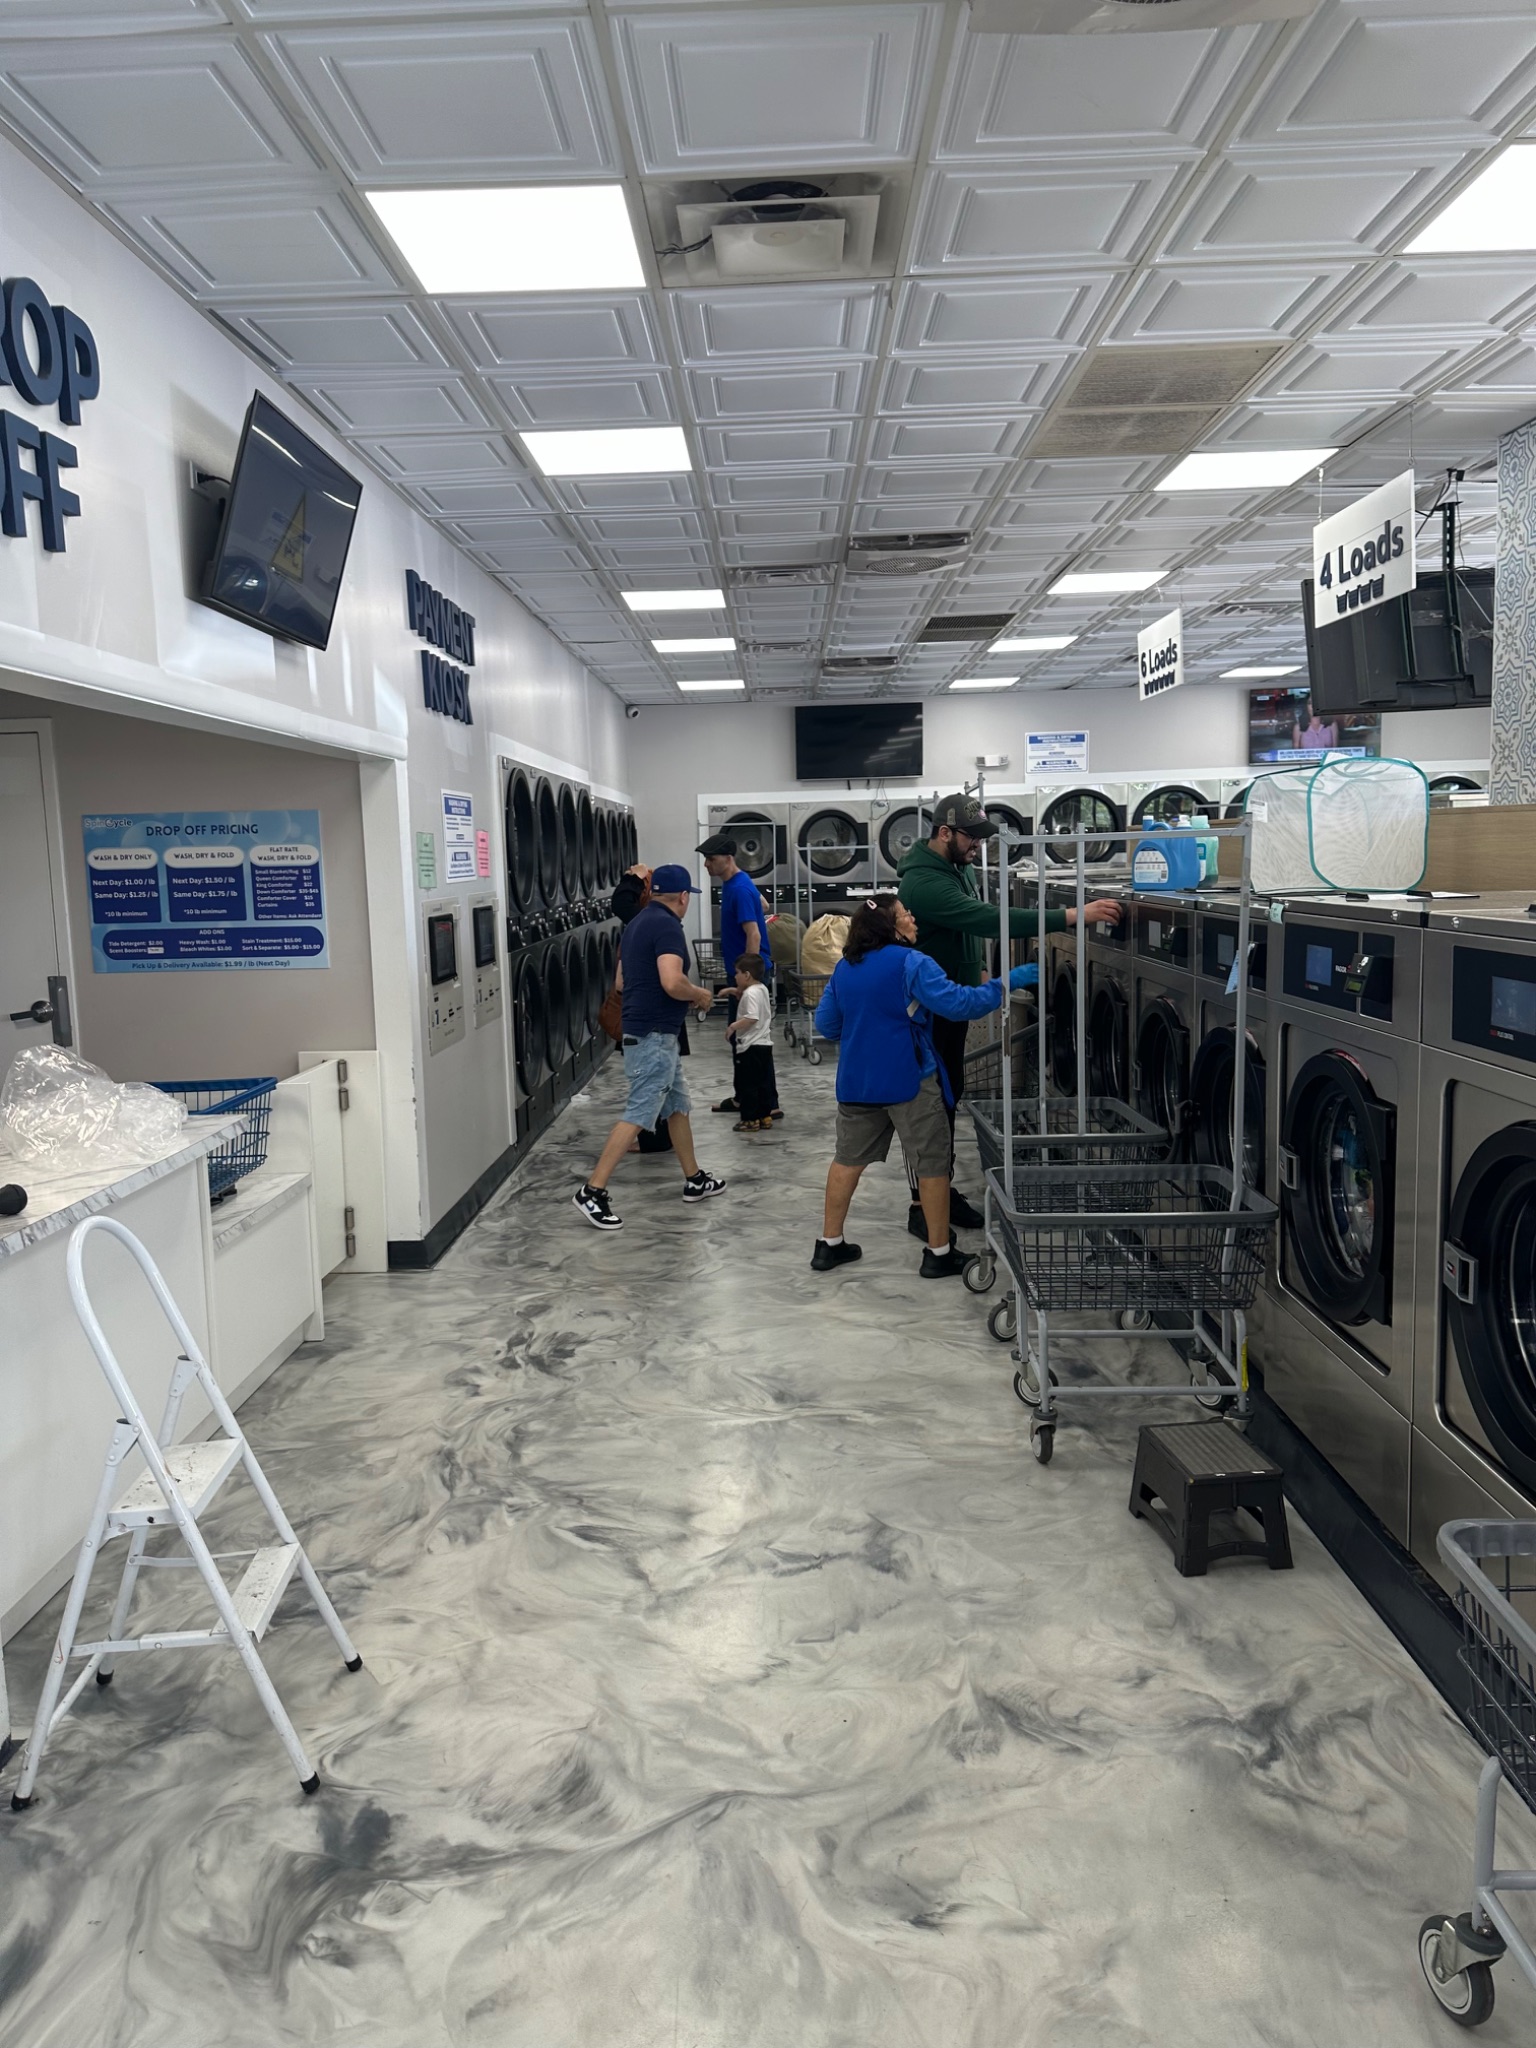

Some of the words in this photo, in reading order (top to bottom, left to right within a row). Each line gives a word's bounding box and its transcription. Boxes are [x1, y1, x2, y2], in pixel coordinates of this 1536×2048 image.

[0, 276, 100, 426] OP
[0, 408, 81, 552] FF
[1320, 552, 1332, 589] 4
[1338, 520, 1404, 583] Loads
[405, 569, 476, 666] PAYMENT
[421, 649, 474, 725] KIOSK
[1141, 653, 1147, 678] 6
[1149, 638, 1178, 674] Loads
[146, 826, 180, 836] DROP
[184, 825, 207, 836] OFF
[211, 824, 258, 834] PRICING
